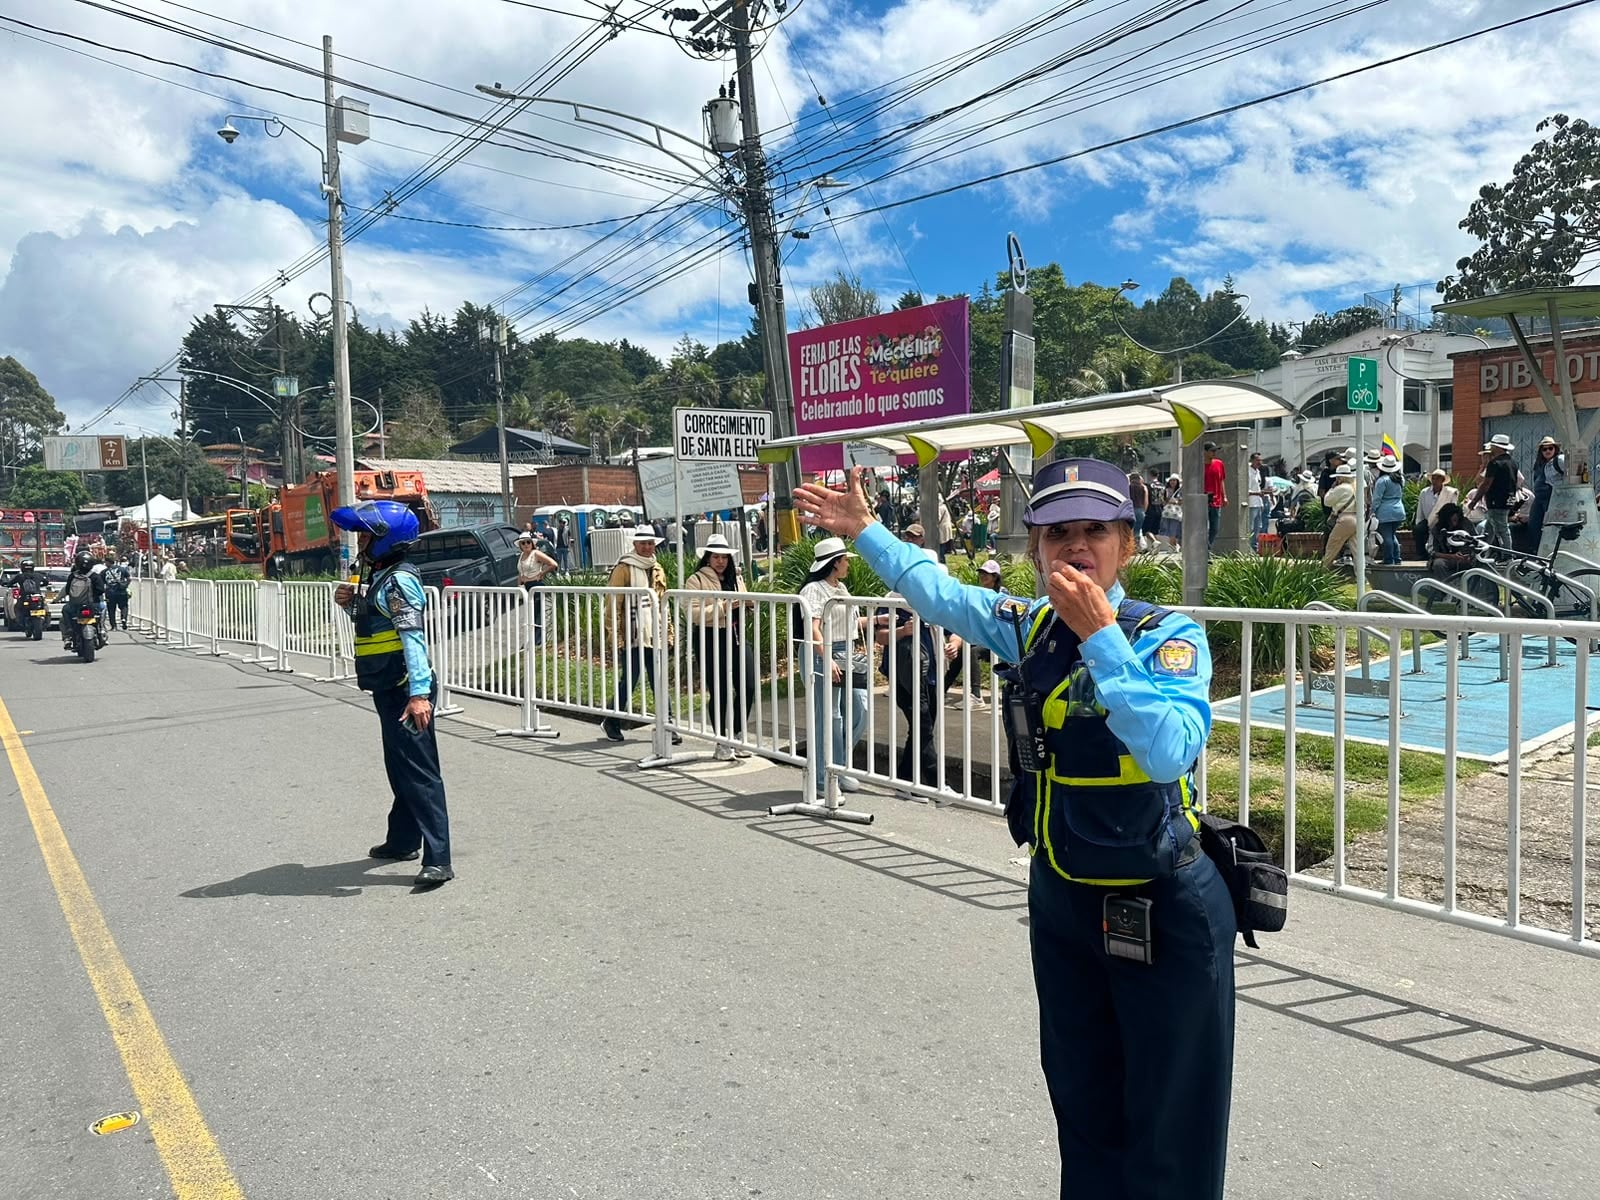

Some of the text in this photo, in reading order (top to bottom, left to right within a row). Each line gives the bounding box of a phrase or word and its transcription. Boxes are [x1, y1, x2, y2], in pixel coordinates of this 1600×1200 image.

[801, 335, 861, 365] FERIA DE LAS
[869, 335, 939, 363] Medellín
[801, 355, 861, 397] FLORES
[870, 363, 939, 384] Te quiere
[1359, 362, 1366, 378] P
[801, 387, 944, 421] Celebrando lo que somos
[684, 413, 765, 436] CORREGIMIENTO
[107, 448, 116, 457] 7
[681, 436, 695, 456] DE
[697, 436, 732, 457] SANTA
